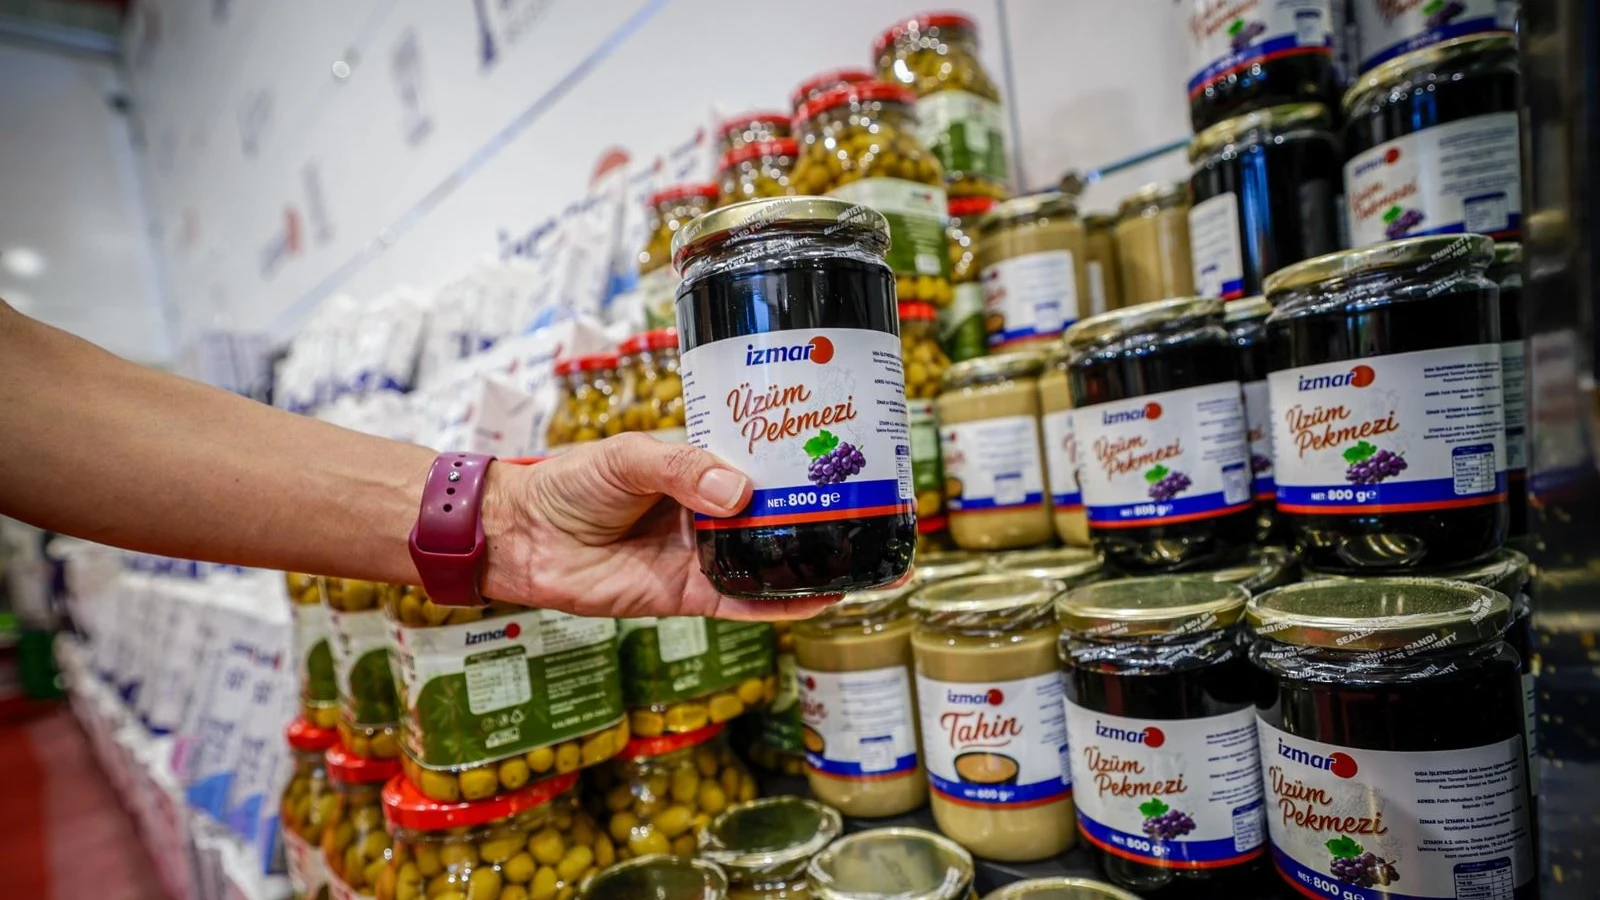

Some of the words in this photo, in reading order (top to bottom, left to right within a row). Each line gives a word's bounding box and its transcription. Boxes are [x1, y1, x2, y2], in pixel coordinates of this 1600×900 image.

[746, 343, 815, 366] izmar
[1298, 371, 1357, 392] izmar
[727, 382, 811, 423] Üzüm
[741, 395, 857, 454] Pekmezi
[1103, 410, 1147, 425] izmar
[1286, 404, 1351, 434] Üzüm
[1296, 411, 1400, 459] Pekmezi
[767, 498, 787, 508] NET:
[788, 494, 818, 507] 800
[1328, 490, 1354, 501] 800
[947, 689, 992, 705] izmar
[940, 711, 1023, 749] Tahin
[1096, 720, 1148, 743] izmar
[1084, 746, 1145, 774] Üzüm
[1278, 737, 1337, 771] izmar
[1094, 773, 1188, 798] Pekmezi
[1269, 766, 1333, 805] Üzüm
[1279, 798, 1388, 836] Pekmezi
[1127, 836, 1150, 852] 800
[1297, 871, 1313, 885] NET:
[1313, 877, 1340, 896] 800
